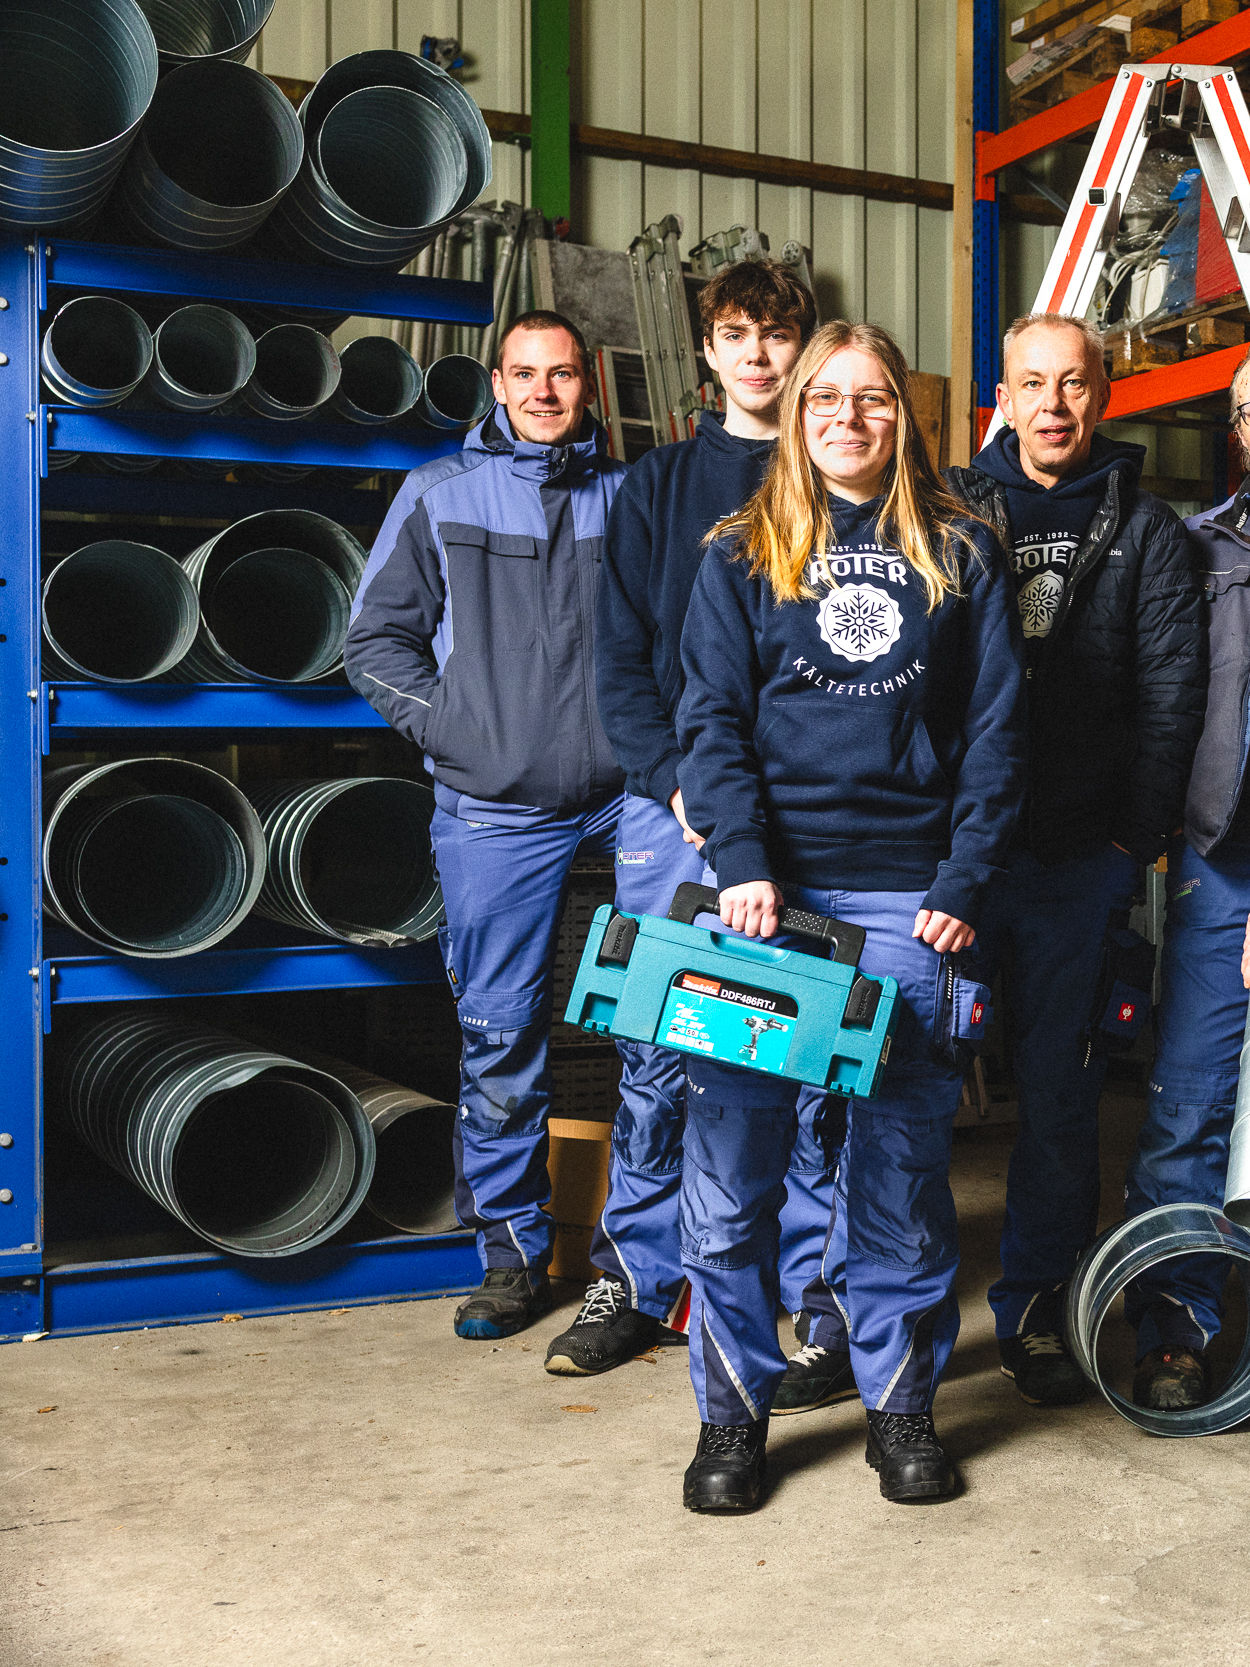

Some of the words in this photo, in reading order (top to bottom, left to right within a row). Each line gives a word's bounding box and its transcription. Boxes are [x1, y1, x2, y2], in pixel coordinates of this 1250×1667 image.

[831, 545, 854, 553] EST.
[858, 543, 883, 552] 1932
[1024, 534, 1043, 543] EST.
[1047, 531, 1069, 540] 1932
[810, 553, 909, 587] ROTER
[793, 656, 926, 697] KÄLTETECHNIK
[720, 989, 776, 1011] DDF486RTJ
